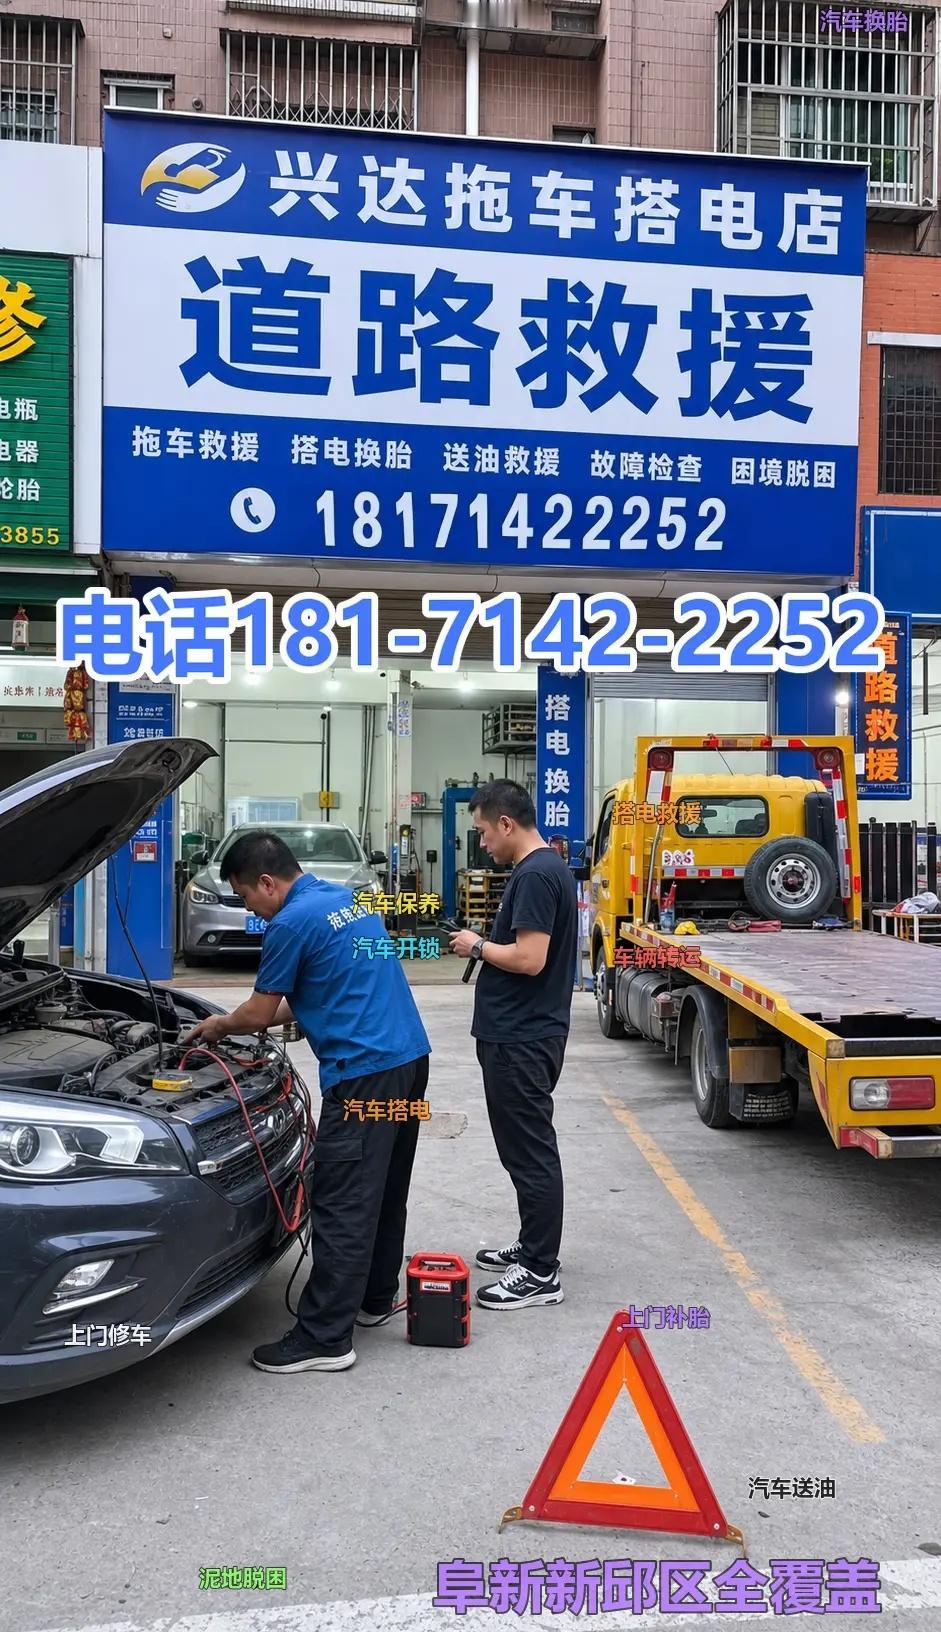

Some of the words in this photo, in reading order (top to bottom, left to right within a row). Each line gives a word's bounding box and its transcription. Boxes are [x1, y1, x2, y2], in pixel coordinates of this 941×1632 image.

[269, 150, 843, 255] 兴达拖车搭电店
[179, 255, 814, 424] 道路救援
[132, 426, 260, 463] 拖车救援
[291, 435, 413, 470] 搭电换胎
[443, 443, 561, 477] 送油救援
[591, 450, 702, 483] 故障检查
[731, 457, 837, 489] 困境脱困
[0, 525, 60, 545] 3855
[316, 490, 727, 551] 18171422252
[545, 694, 570, 827] 搭电换胎
